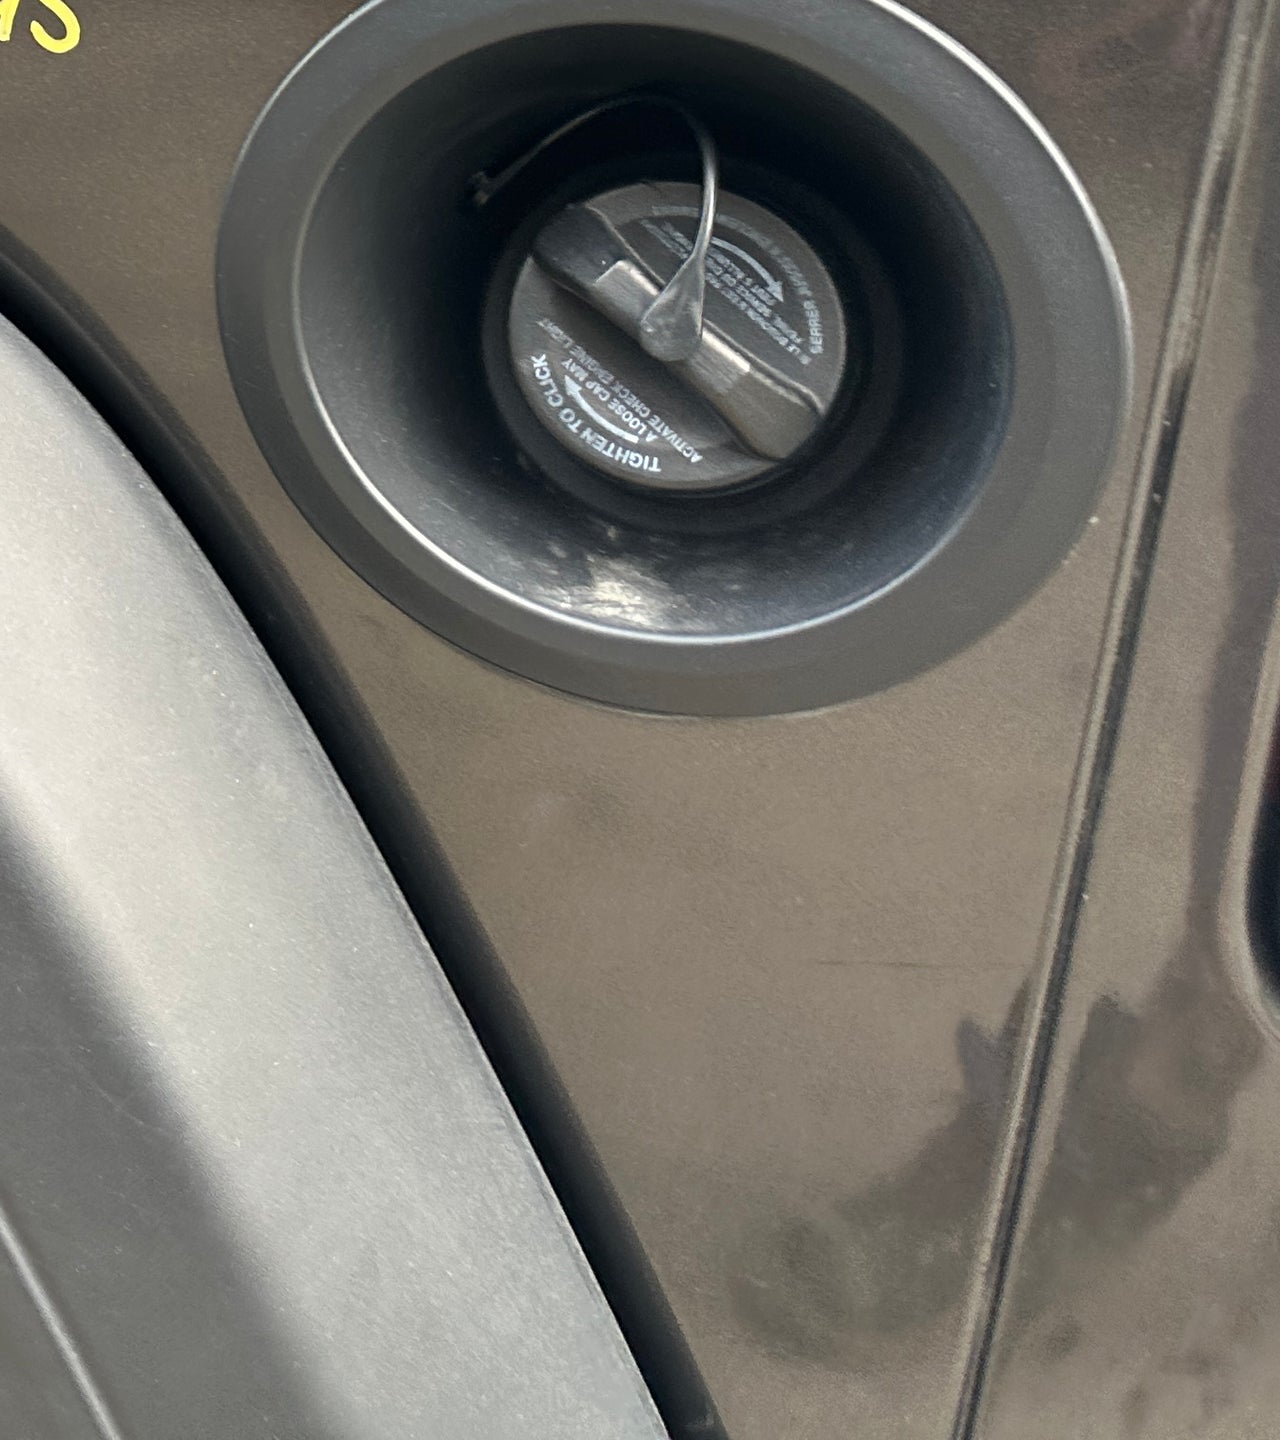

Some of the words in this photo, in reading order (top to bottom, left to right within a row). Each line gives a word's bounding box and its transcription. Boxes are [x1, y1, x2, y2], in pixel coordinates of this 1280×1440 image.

[531, 353, 564, 407] CLICK
[561, 358, 589, 382] MAY
[585, 380, 611, 401] CAP
[611, 381, 651, 417] CHECK
[558, 407, 584, 433] TO
[608, 397, 647, 435] LOOSE
[580, 429, 662, 472] TIGHTEN
[644, 432, 659, 443] A
[648, 414, 703, 463] ACTIVATE
